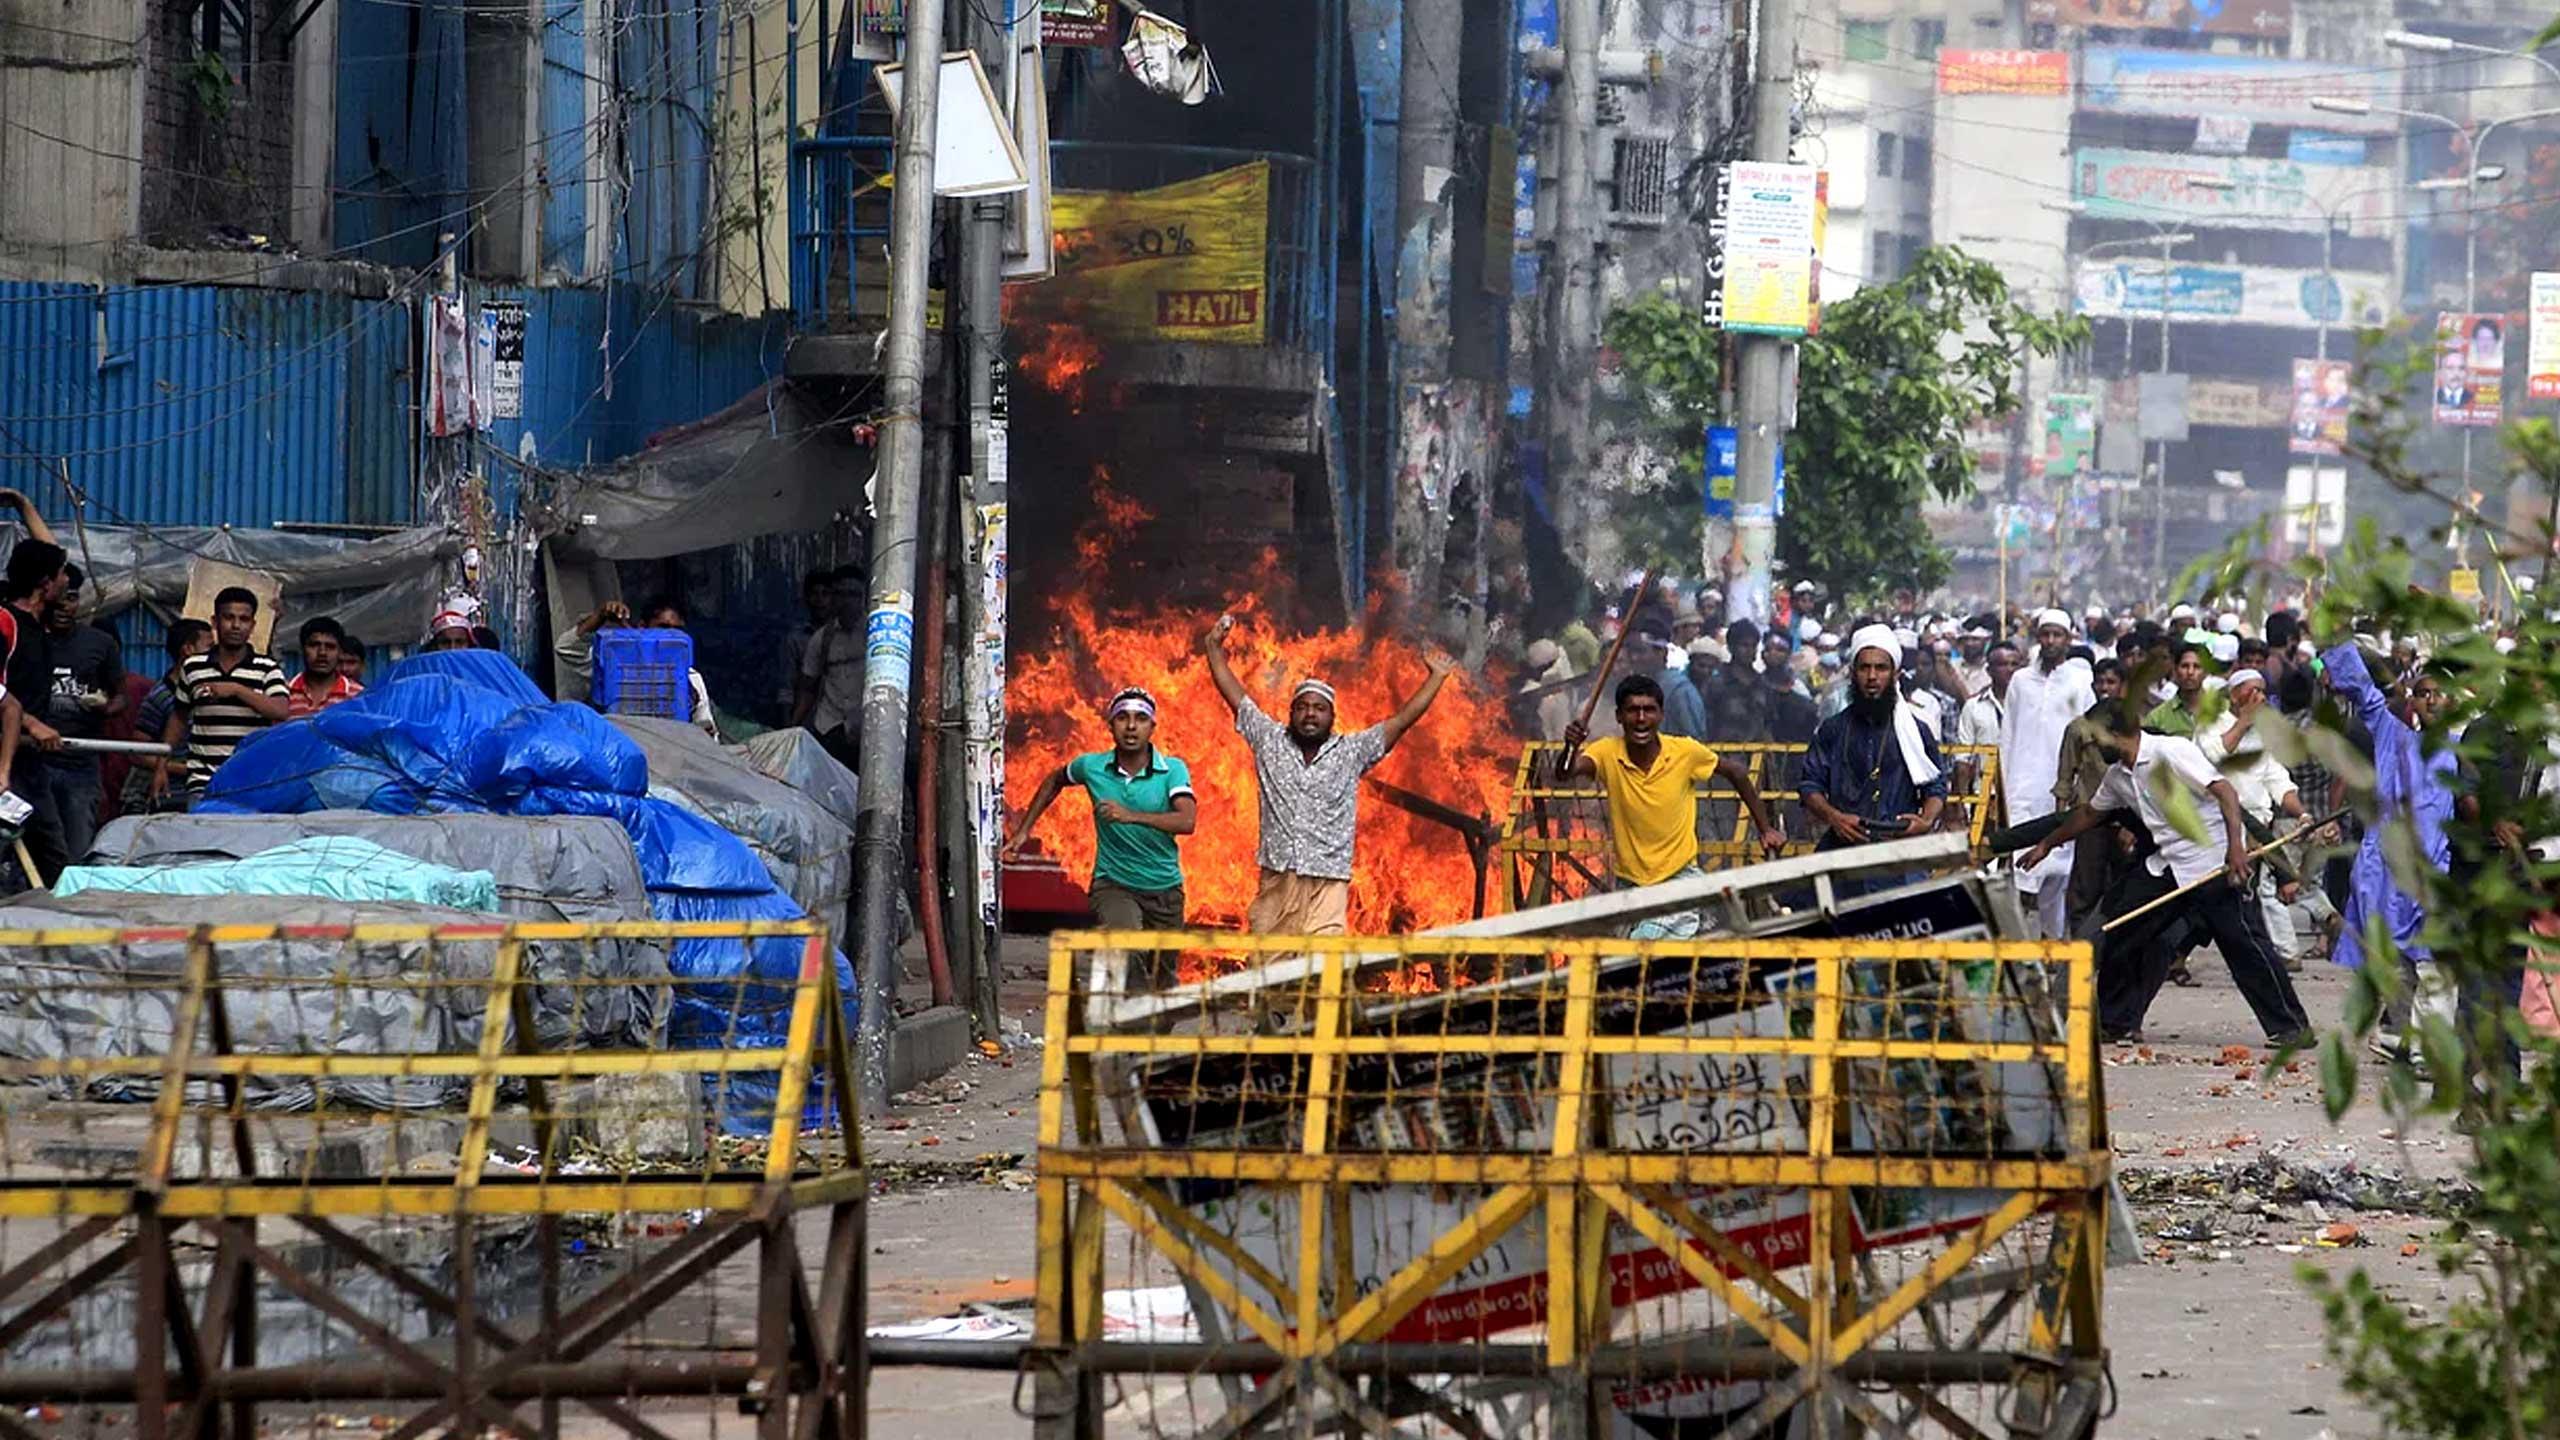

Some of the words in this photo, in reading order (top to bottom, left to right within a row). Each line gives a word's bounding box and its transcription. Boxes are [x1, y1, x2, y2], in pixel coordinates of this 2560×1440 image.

[1167, 293, 1251, 322] HATIL
[1765, 1230, 1808, 1257] ISO
[1424, 1290, 1532, 1327] Company
